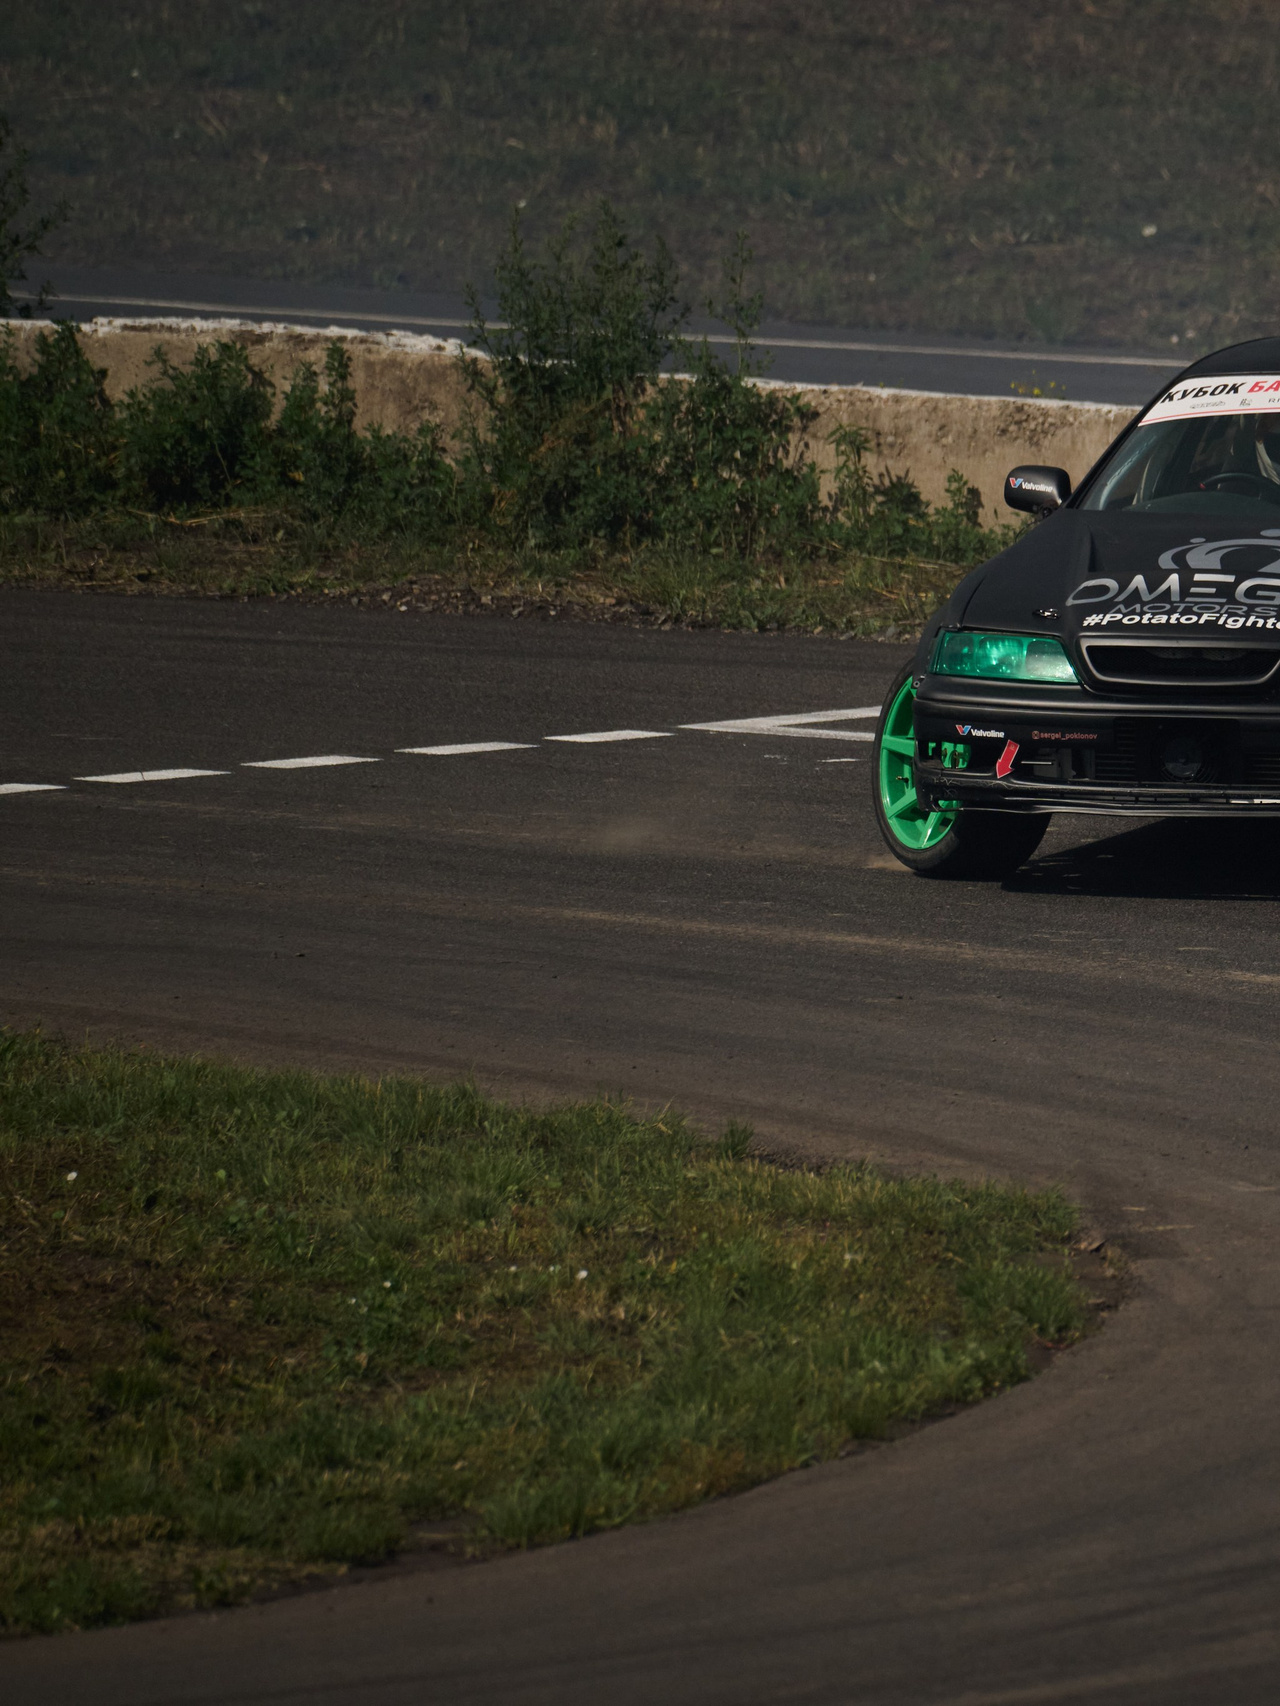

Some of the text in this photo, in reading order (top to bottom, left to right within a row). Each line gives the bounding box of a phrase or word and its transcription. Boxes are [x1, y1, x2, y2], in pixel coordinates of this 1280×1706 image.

[1161, 382, 1245, 403] КУБОК
[1021, 481, 1053, 493] Valvoline
[1109, 603, 1278, 617] MOTORS
[971, 728, 1005, 738] Valvoline
